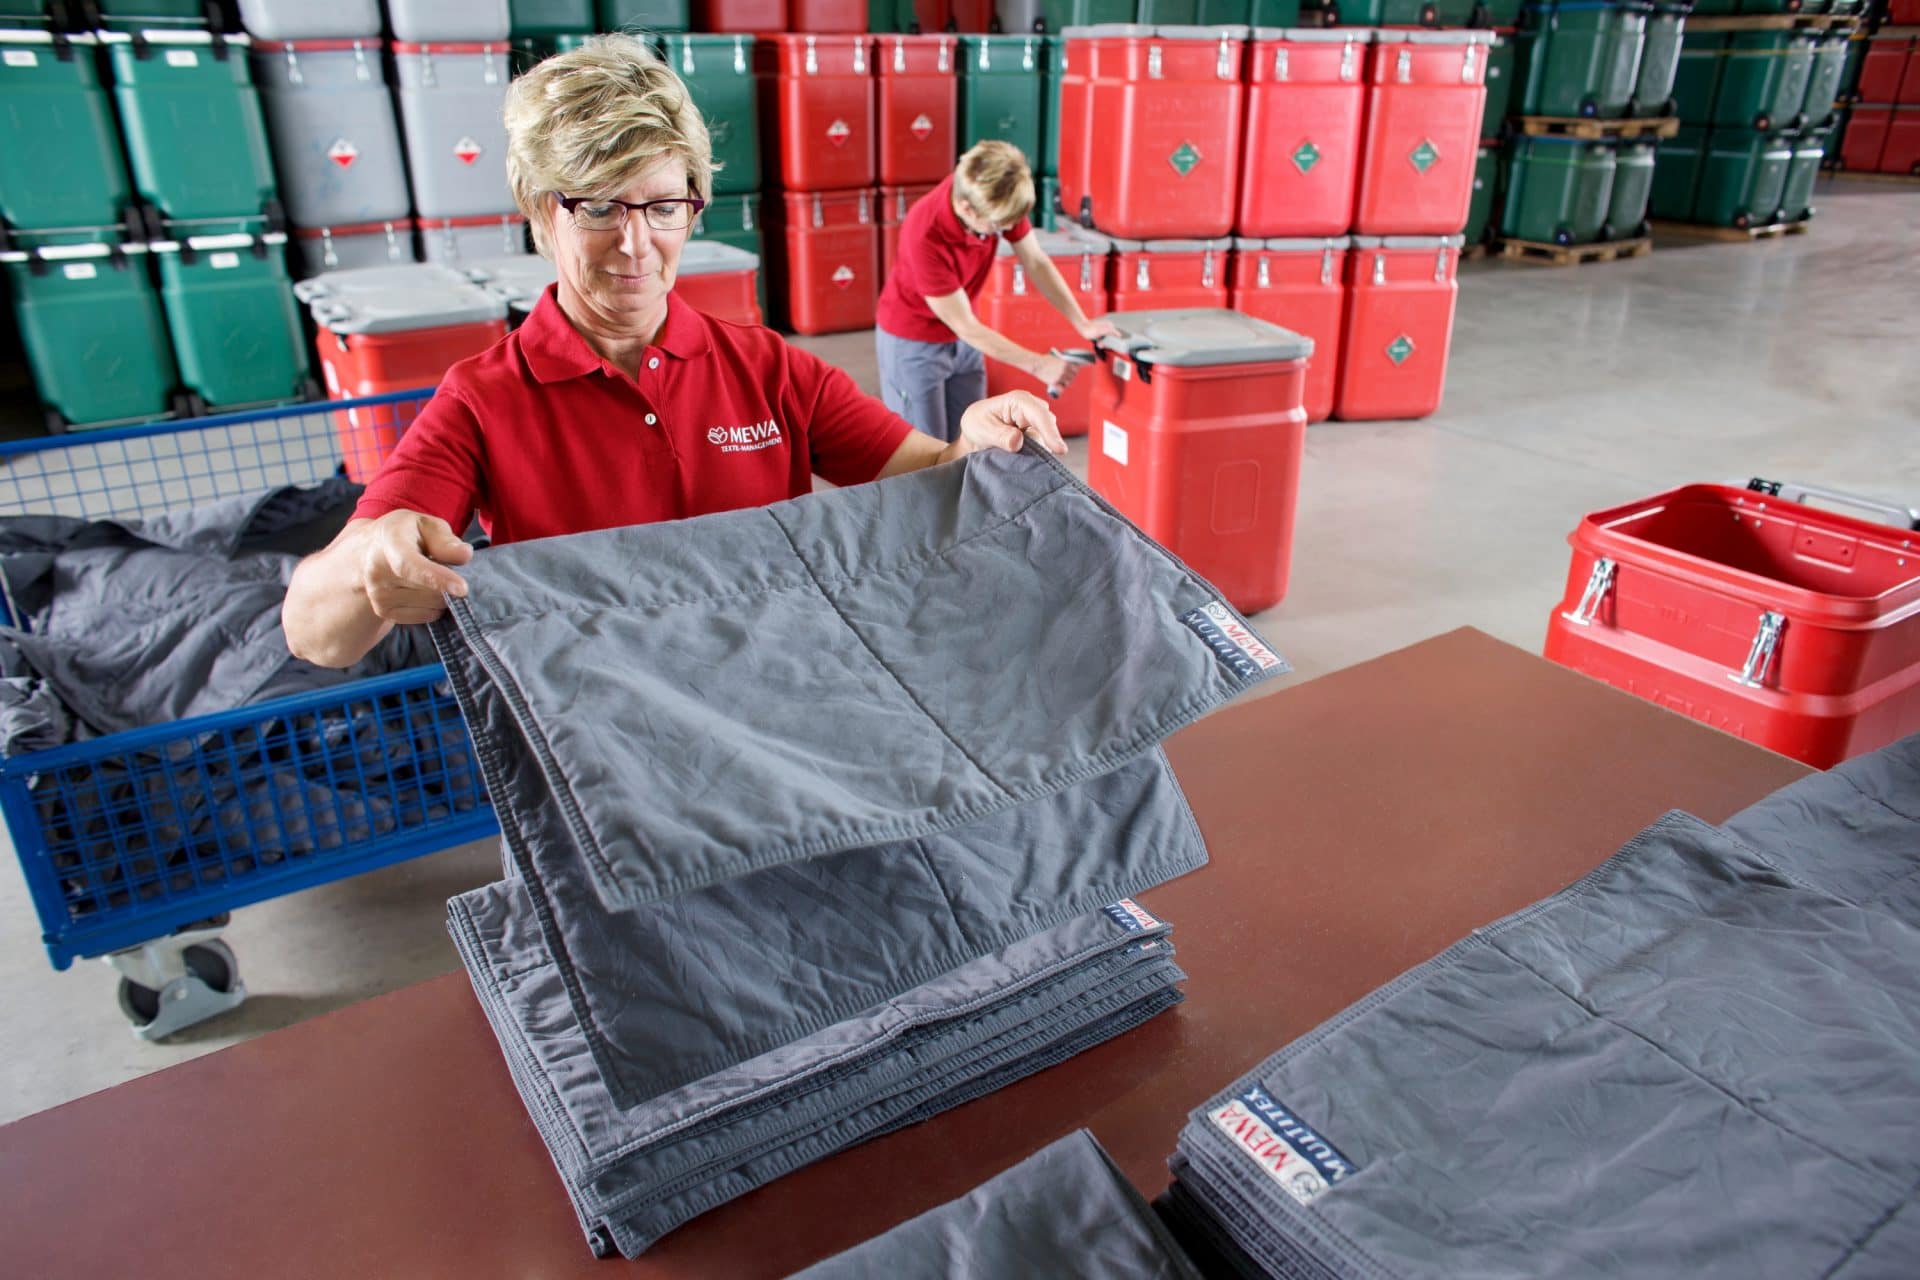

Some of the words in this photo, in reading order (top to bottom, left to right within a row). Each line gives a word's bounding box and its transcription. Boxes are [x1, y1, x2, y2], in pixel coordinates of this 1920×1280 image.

[730, 418, 780, 443] MEWA
[1187, 613, 1255, 676] MULTITEX
[1224, 623, 1275, 668] MEWA
[1219, 1103, 1297, 1172] MEWA
[1243, 1088, 1346, 1181] MULTITEX
